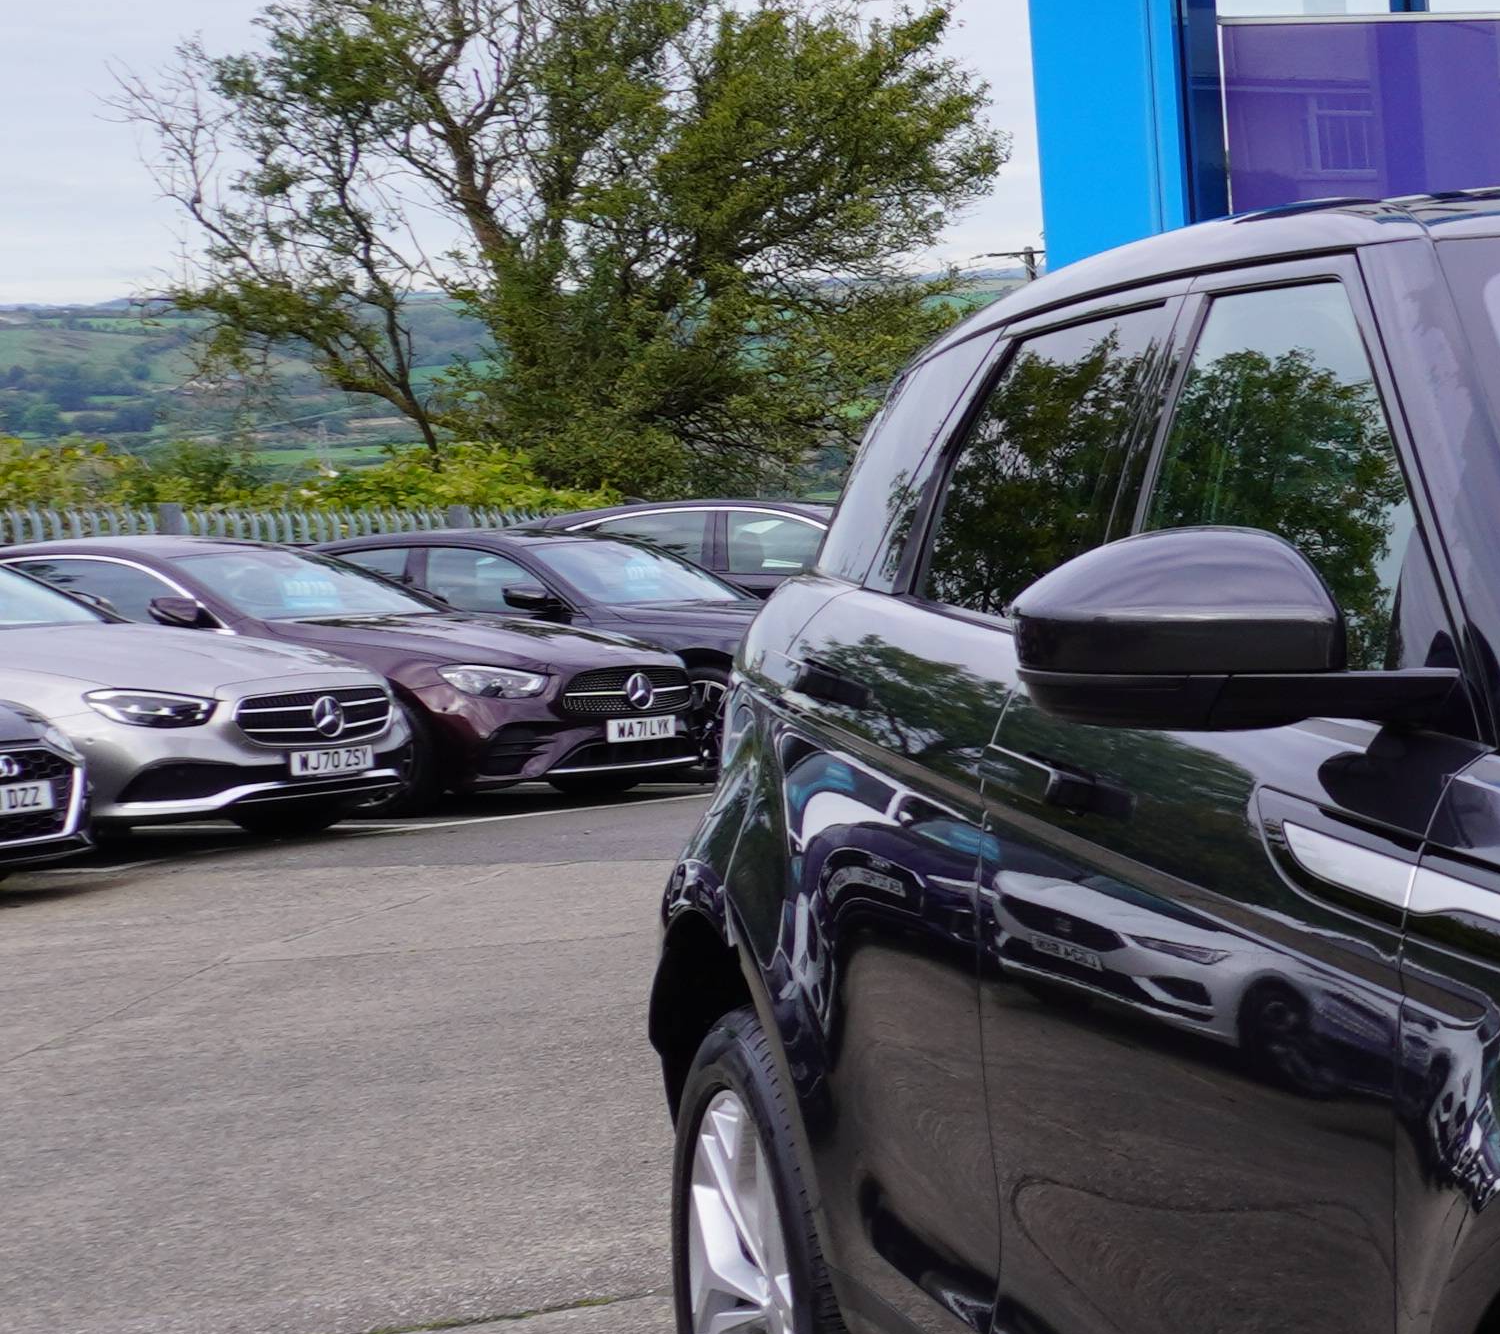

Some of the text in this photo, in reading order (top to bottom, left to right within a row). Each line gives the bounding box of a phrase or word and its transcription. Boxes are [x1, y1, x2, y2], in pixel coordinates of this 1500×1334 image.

[617, 718, 669, 738] WA71 LYK
[299, 748, 368, 772] WJ70 ZSY
[7, 786, 42, 809] DZZ
